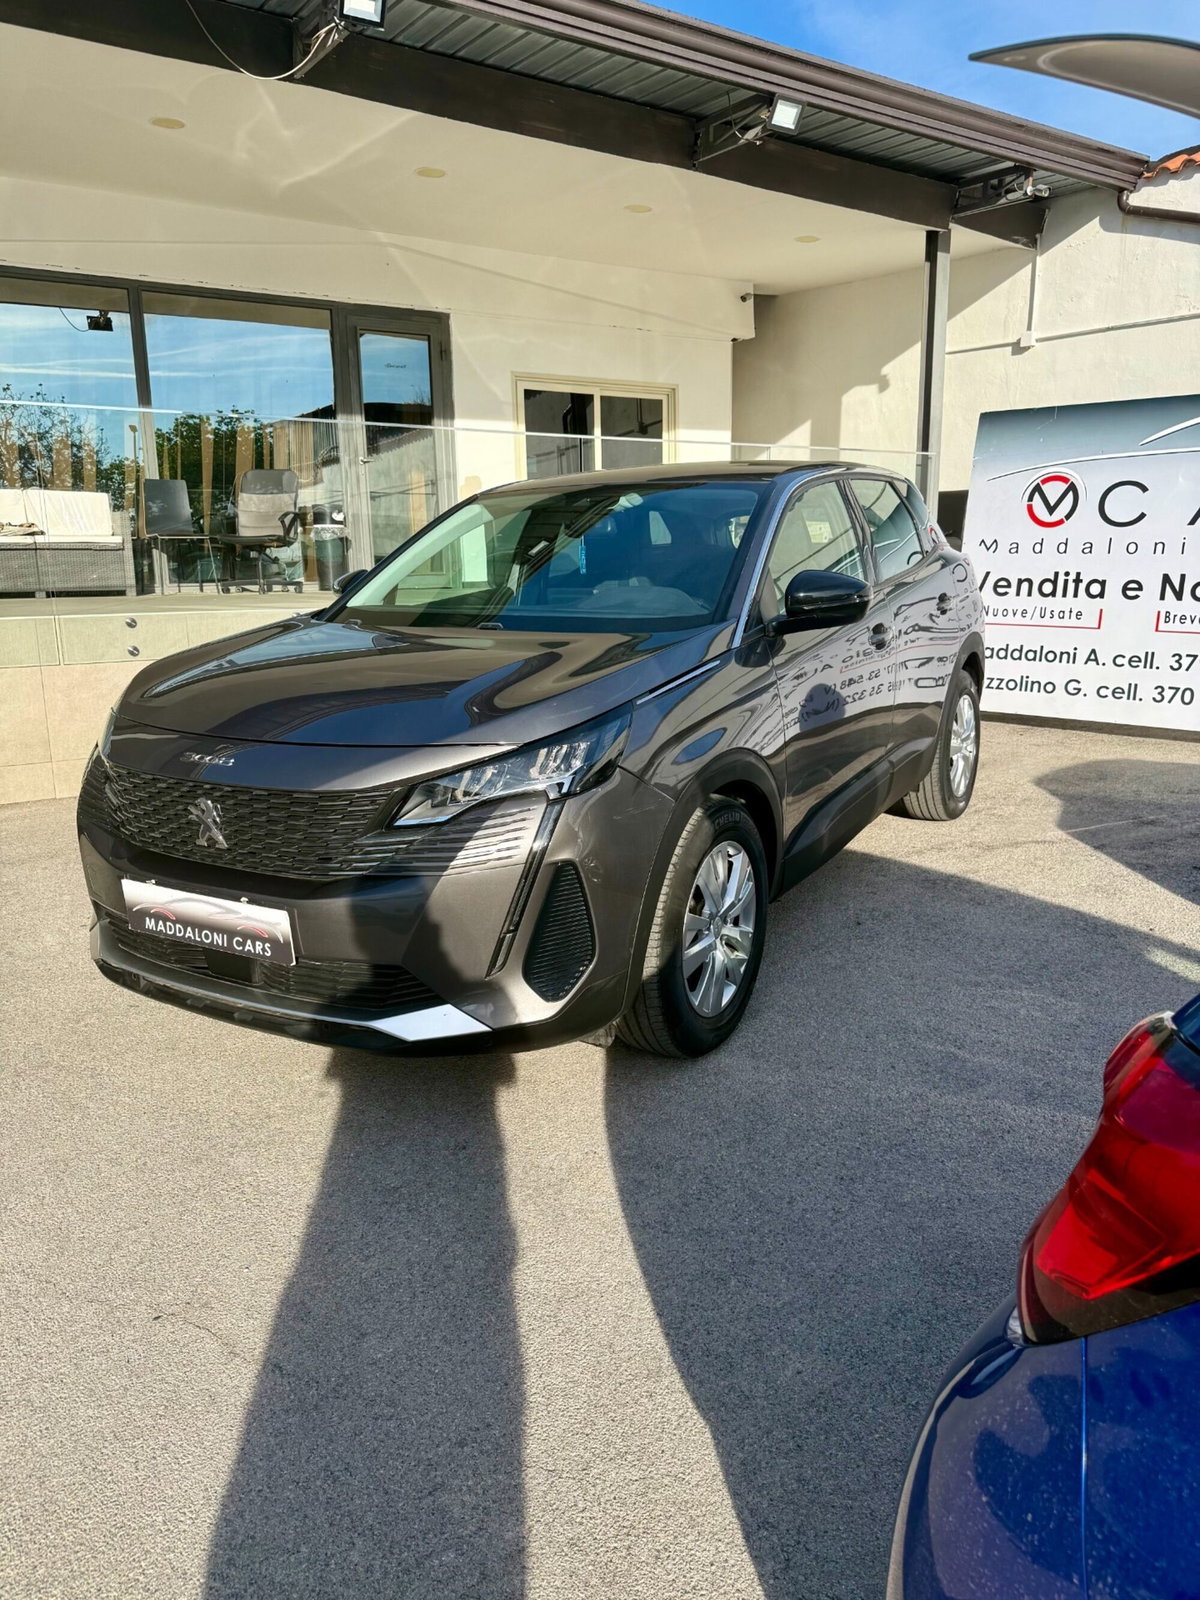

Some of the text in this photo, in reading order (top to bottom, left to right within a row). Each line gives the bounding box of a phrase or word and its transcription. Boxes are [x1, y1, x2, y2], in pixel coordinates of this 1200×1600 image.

[979, 537, 1186, 555] Maddaloni
[1121, 579, 1144, 601] e
[1164, 610, 1200, 624] Brev
[985, 643, 1077, 664] addaloni
[1083, 648, 1106, 667] A.
[1112, 651, 1160, 670] cell.
[1169, 653, 1200, 672] 37
[985, 675, 1195, 706] zzolino G. cell. 370
[145, 916, 272, 957] MADDALONI CARS
